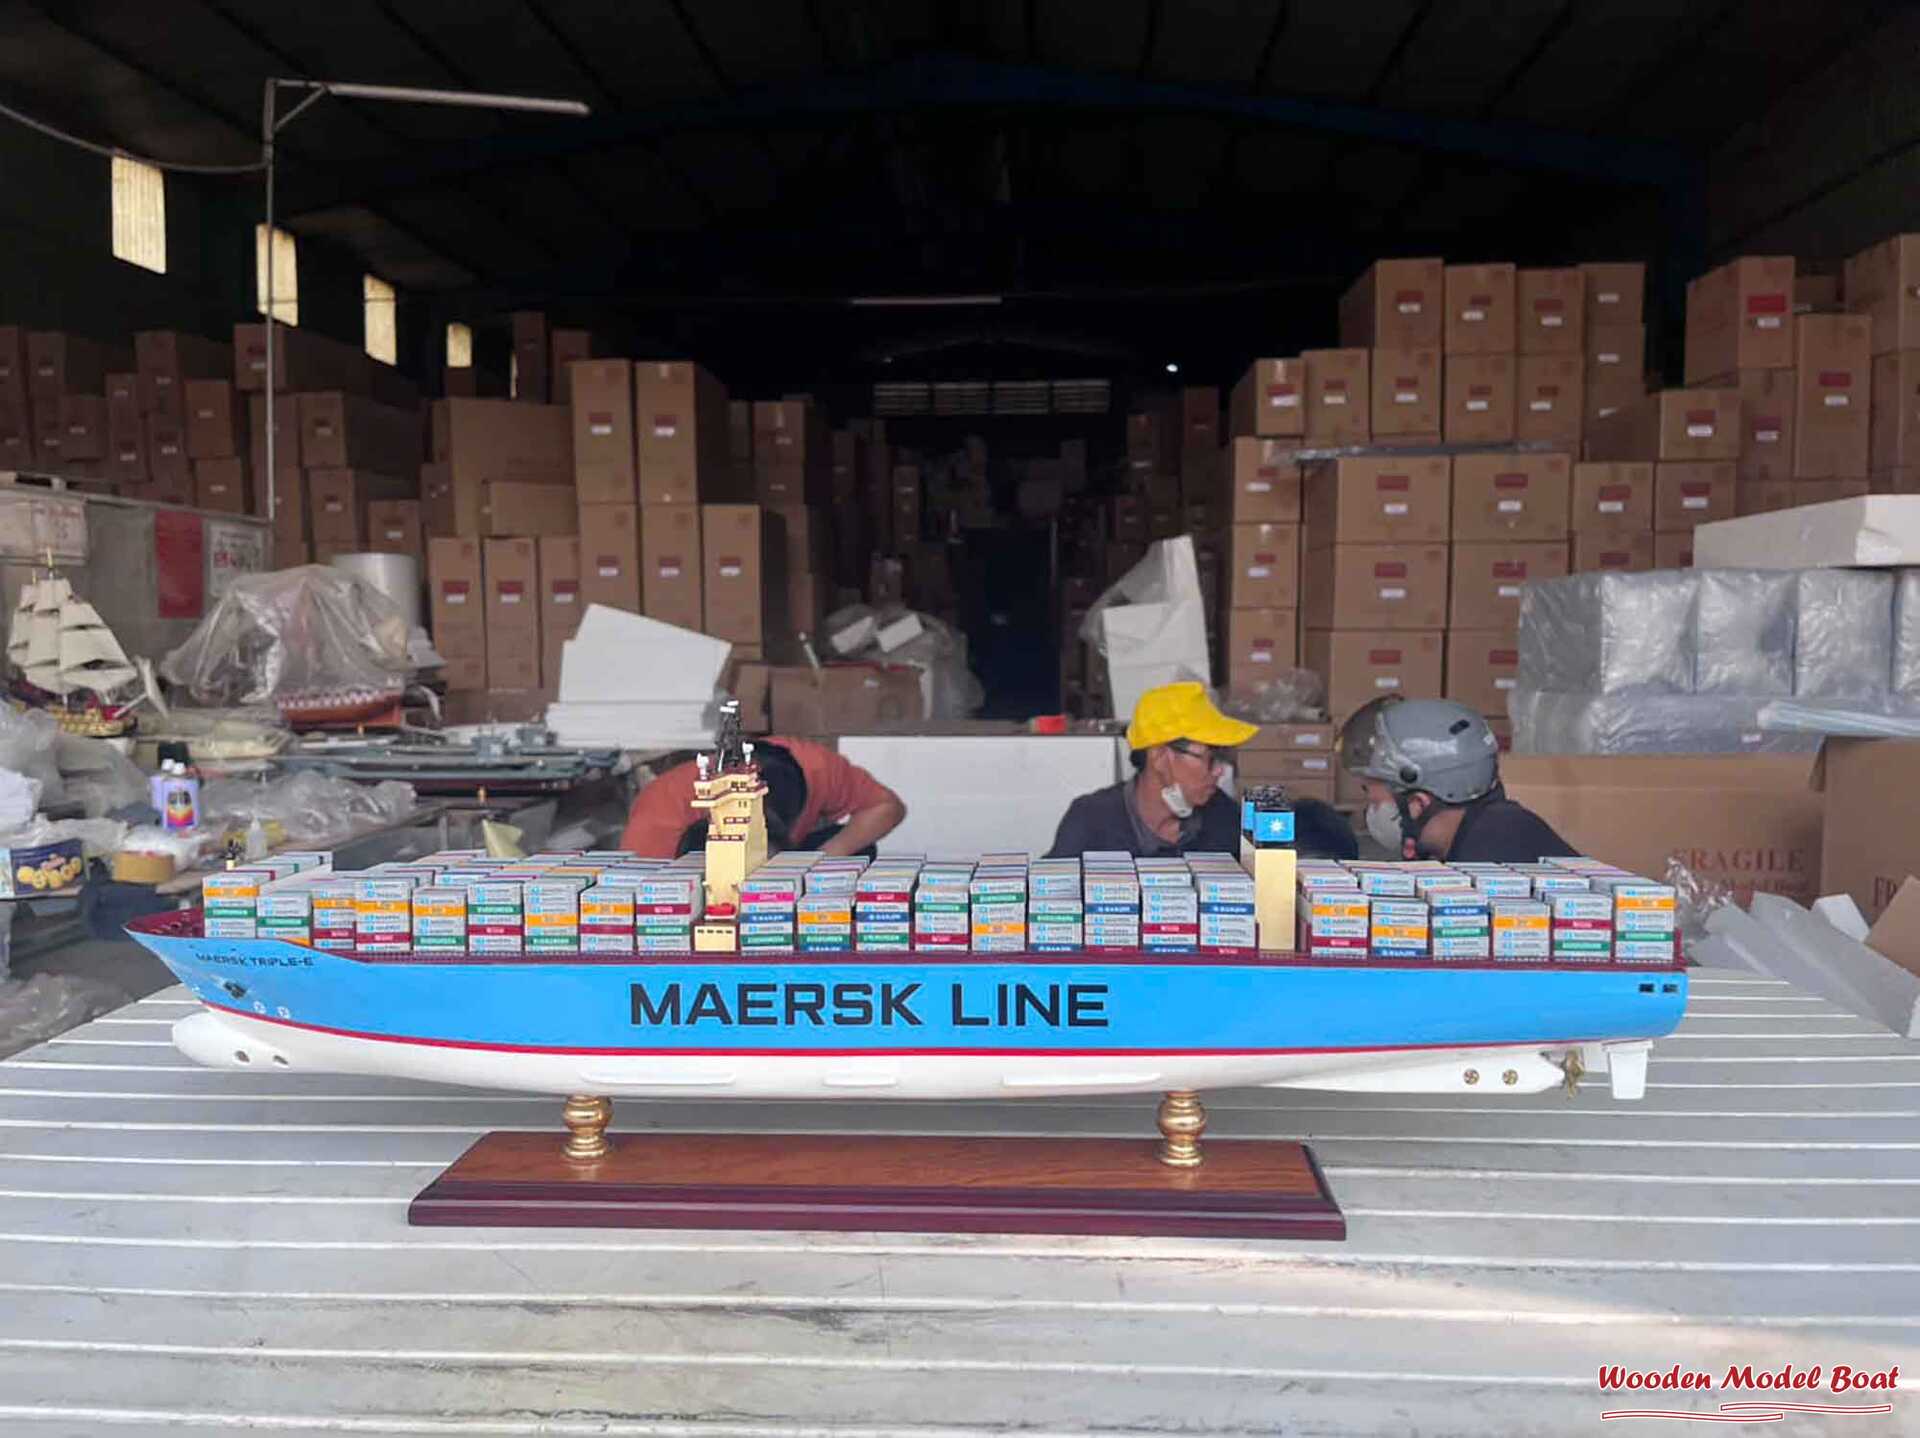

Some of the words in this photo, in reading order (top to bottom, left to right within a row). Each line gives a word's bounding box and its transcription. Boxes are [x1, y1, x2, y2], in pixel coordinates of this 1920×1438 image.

[195, 953, 248, 967] MAERSK
[249, 957, 315, 968] TRIPLE-E
[630, 983, 922, 1026] MAERSK
[951, 983, 1109, 1027] LINE
